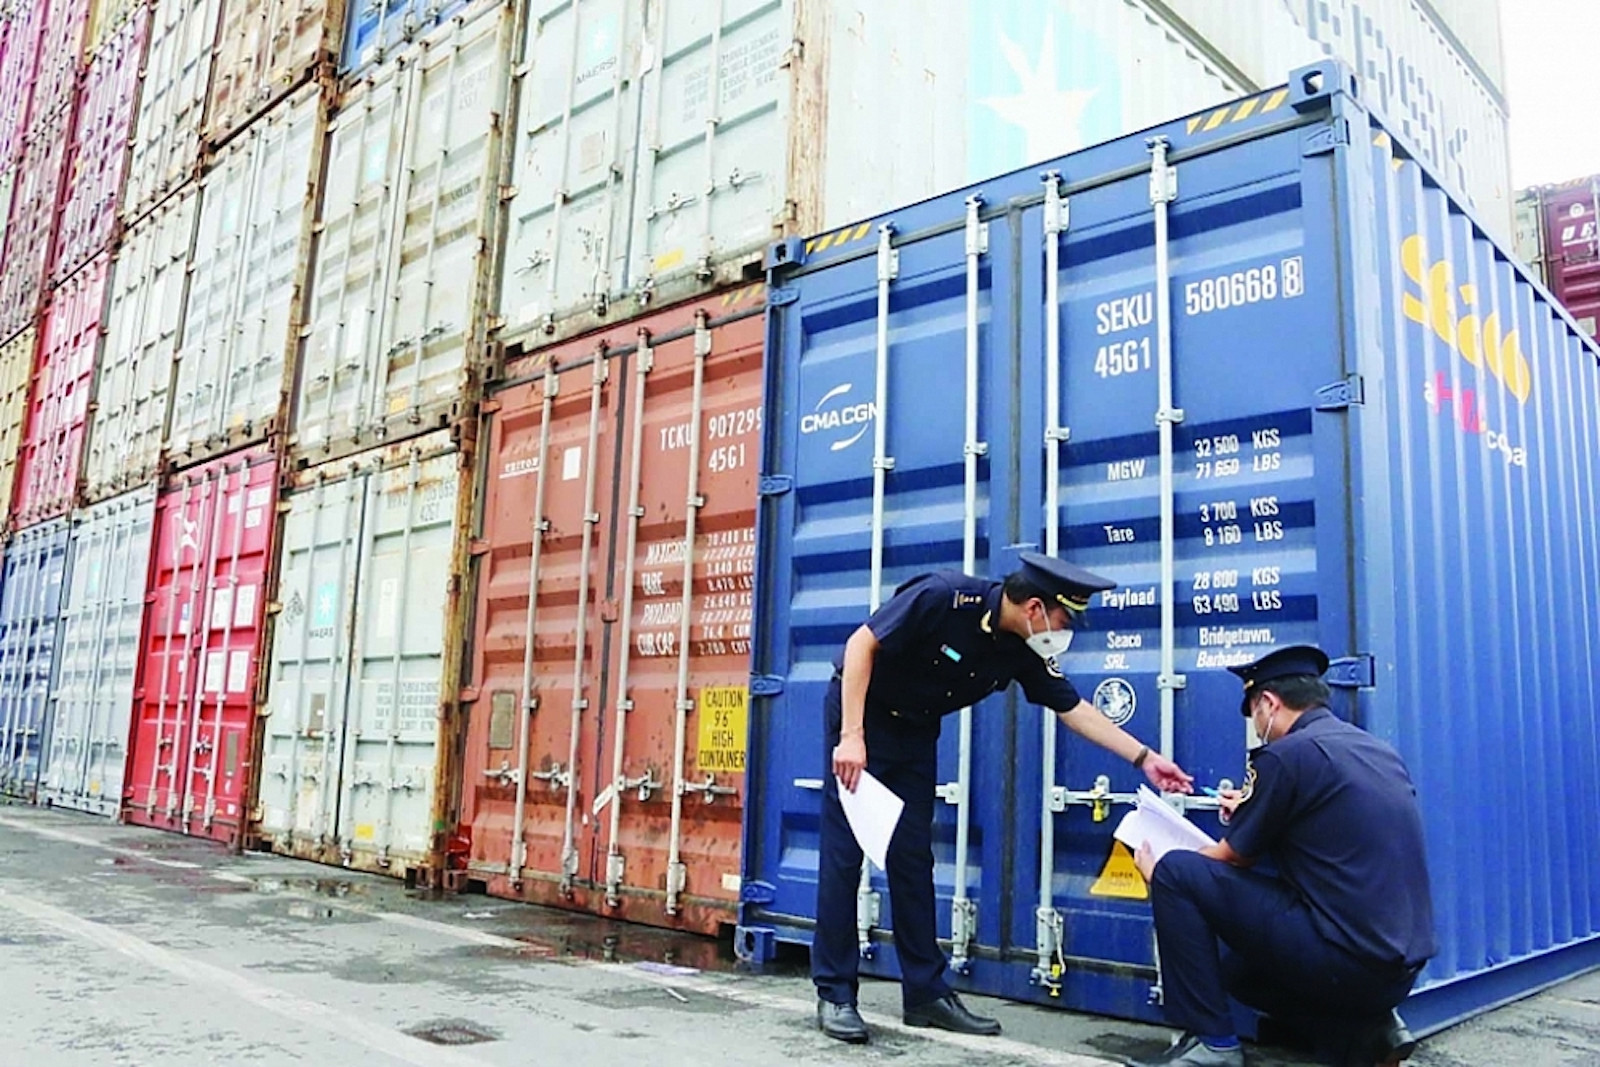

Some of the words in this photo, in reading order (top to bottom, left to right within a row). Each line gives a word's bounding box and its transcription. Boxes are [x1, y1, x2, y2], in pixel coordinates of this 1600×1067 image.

[1096, 292, 1153, 335] SEKU
[1185, 265, 1277, 316] 580668
[1281, 256, 1304, 298] 8
[1094, 337, 1150, 378] 45G1
[801, 410, 840, 433] CMA
[660, 424, 693, 451] TCKU
[708, 443, 745, 473] 45G1
[1107, 459, 1145, 481] MGW
[1194, 438, 1212, 458] 32
[1252, 429, 1281, 449] KGS
[1253, 453, 1281, 472] LBS
[1103, 525, 1135, 544] Tare
[1250, 496, 1279, 518] KGS
[1254, 521, 1284, 542] LBS
[641, 571, 666, 596] TARE
[1101, 587, 1155, 610] Payload
[1252, 566, 1280, 586] KGS
[1252, 591, 1282, 611] LBS
[1106, 631, 1142, 649] Seaco
[1199, 627, 1276, 649] Bridgetown,
[706, 690, 743, 708] CAUTION
[711, 729, 734, 748] HIGH
[699, 749, 746, 769] CONTAINER
